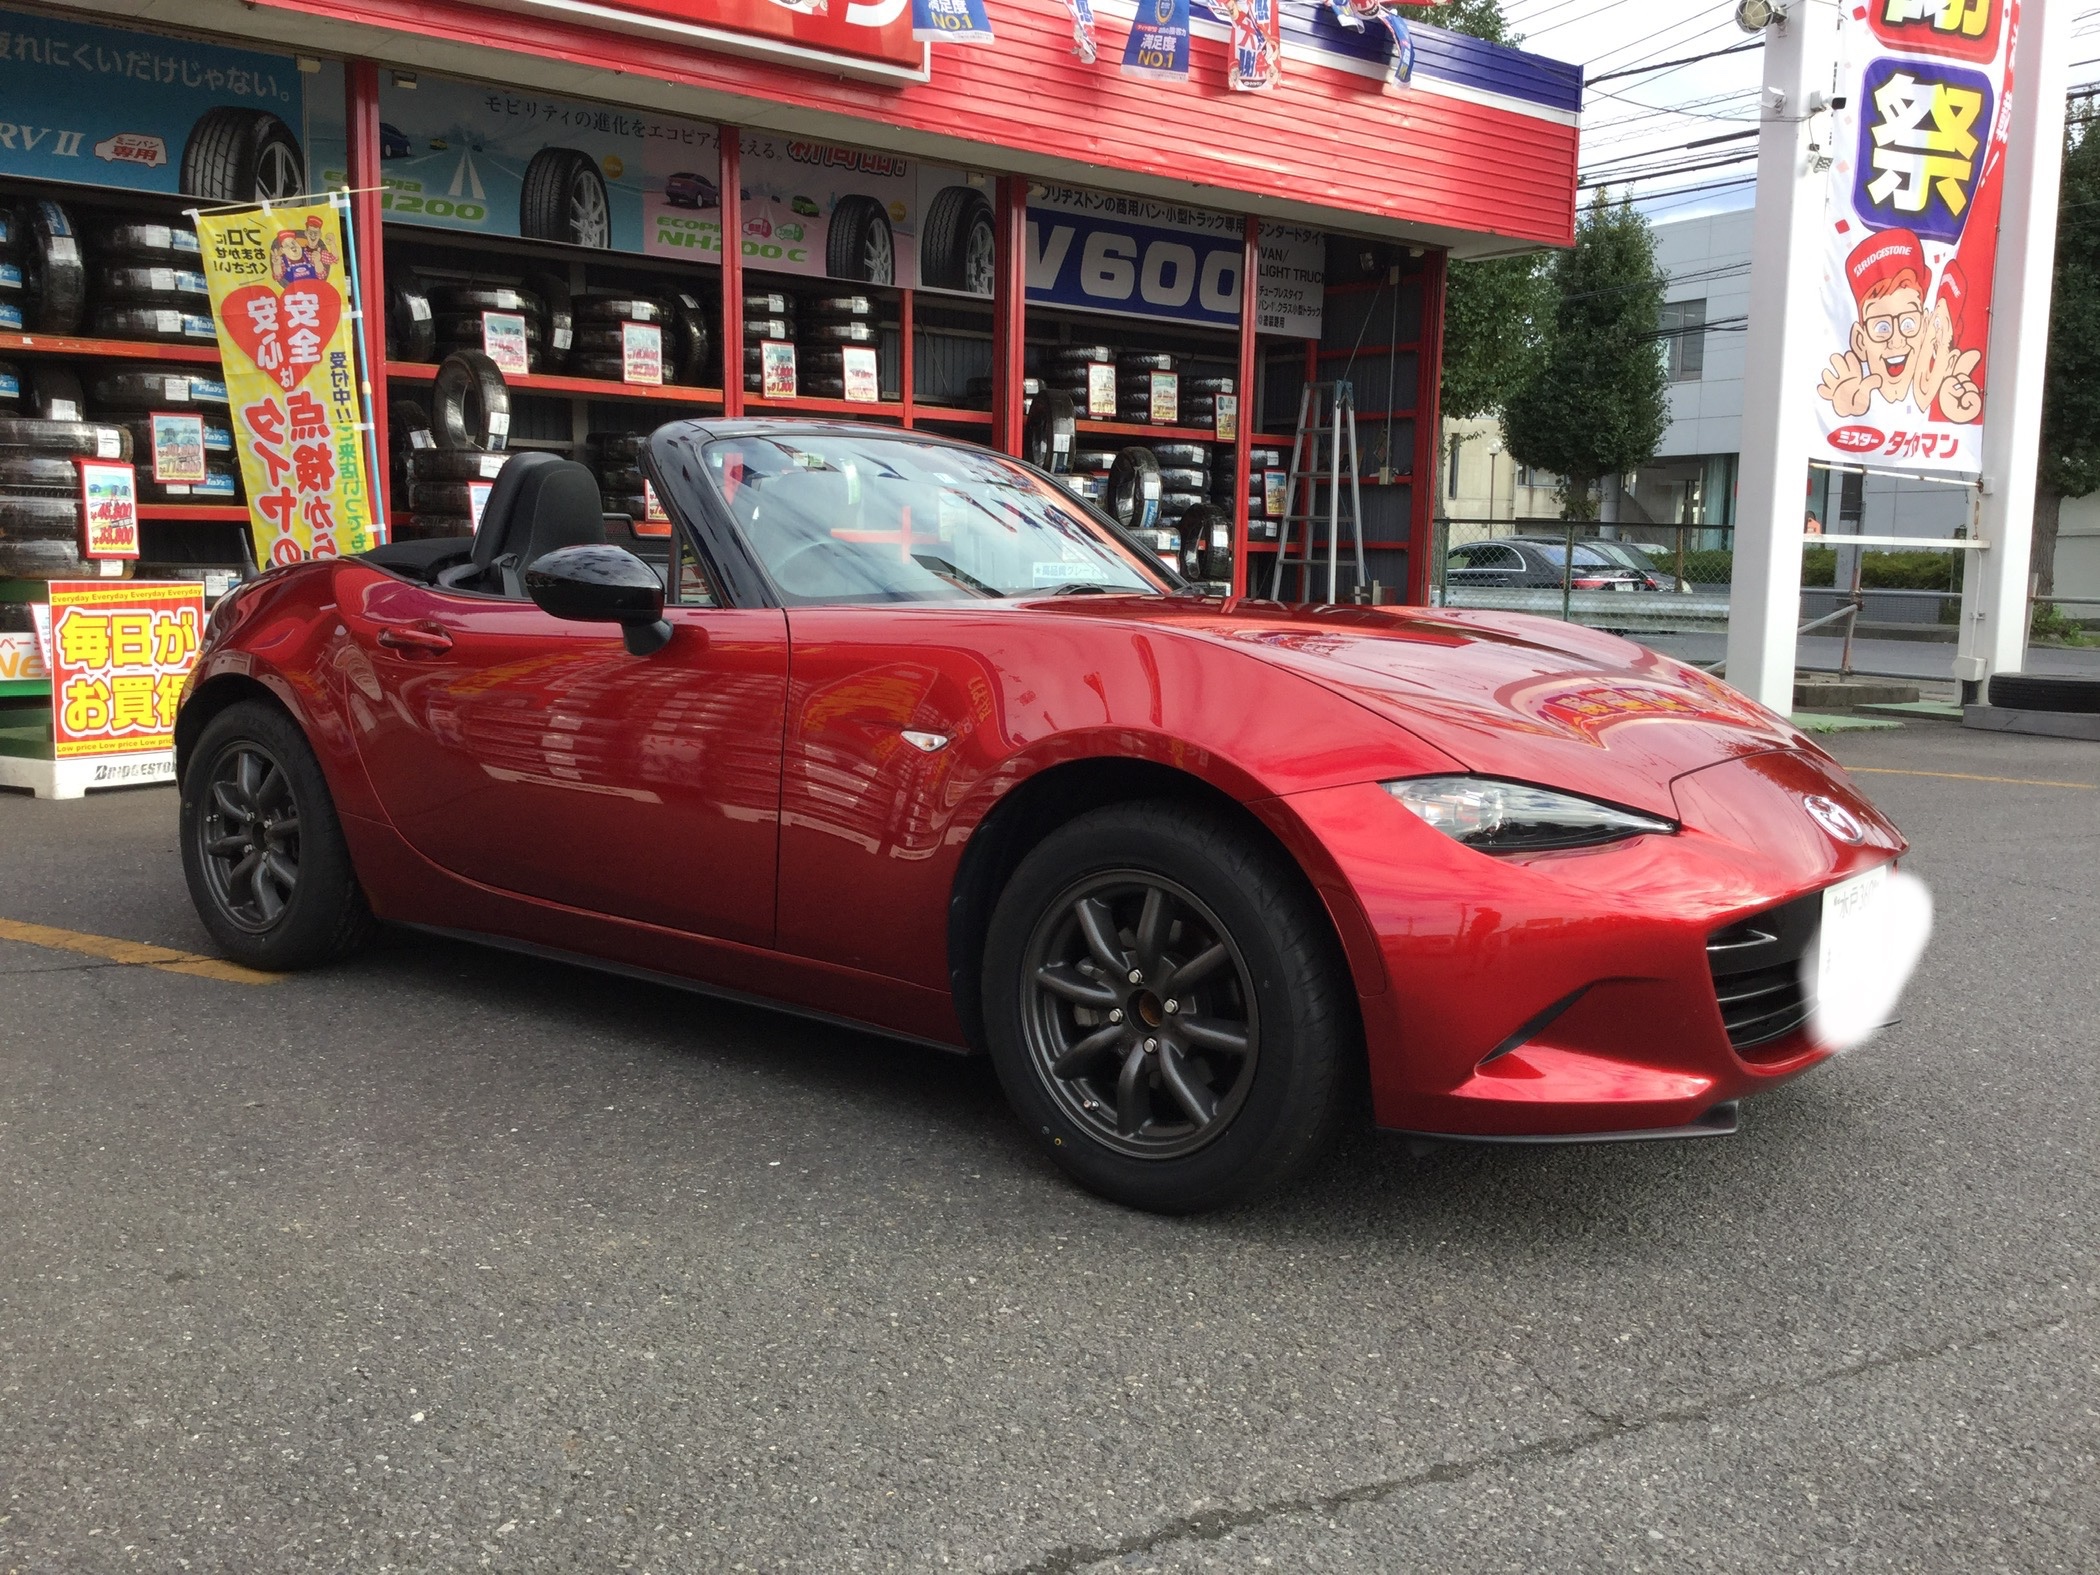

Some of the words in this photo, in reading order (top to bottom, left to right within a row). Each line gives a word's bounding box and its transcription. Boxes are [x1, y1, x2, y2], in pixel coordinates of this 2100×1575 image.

[931, 12, 973, 29] NO.1
[1140, 34, 1177, 52] 満足度
[1138, 50, 1174, 68] NO.1
[485, 96, 784, 162] モビリティの進化をエコピアえる。
[116, 137, 159, 149] ミニバン
[112, 145, 158, 161] 専用
[1261, 246, 1290, 263] VAN/
[1853, 245, 1912, 278] BRIDGESTONE
[1026, 221, 1241, 314] V600
[1260, 264, 1290, 279] LIGHT
[1837, 430, 1880, 447] ミスター
[52, 595, 89, 604] Everyday
[92, 593, 128, 602] Everyday
[131, 590, 166, 600] Everyday
[168, 588, 202, 598] Everyday
[60, 611, 196, 670] 毎日が
[56, 745, 73, 753] Low
[76, 743, 97, 753] price
[99, 741, 116, 749] Low
[118, 740, 138, 751] price
[140, 738, 156, 747] Low
[158, 737, 174, 747] pric
